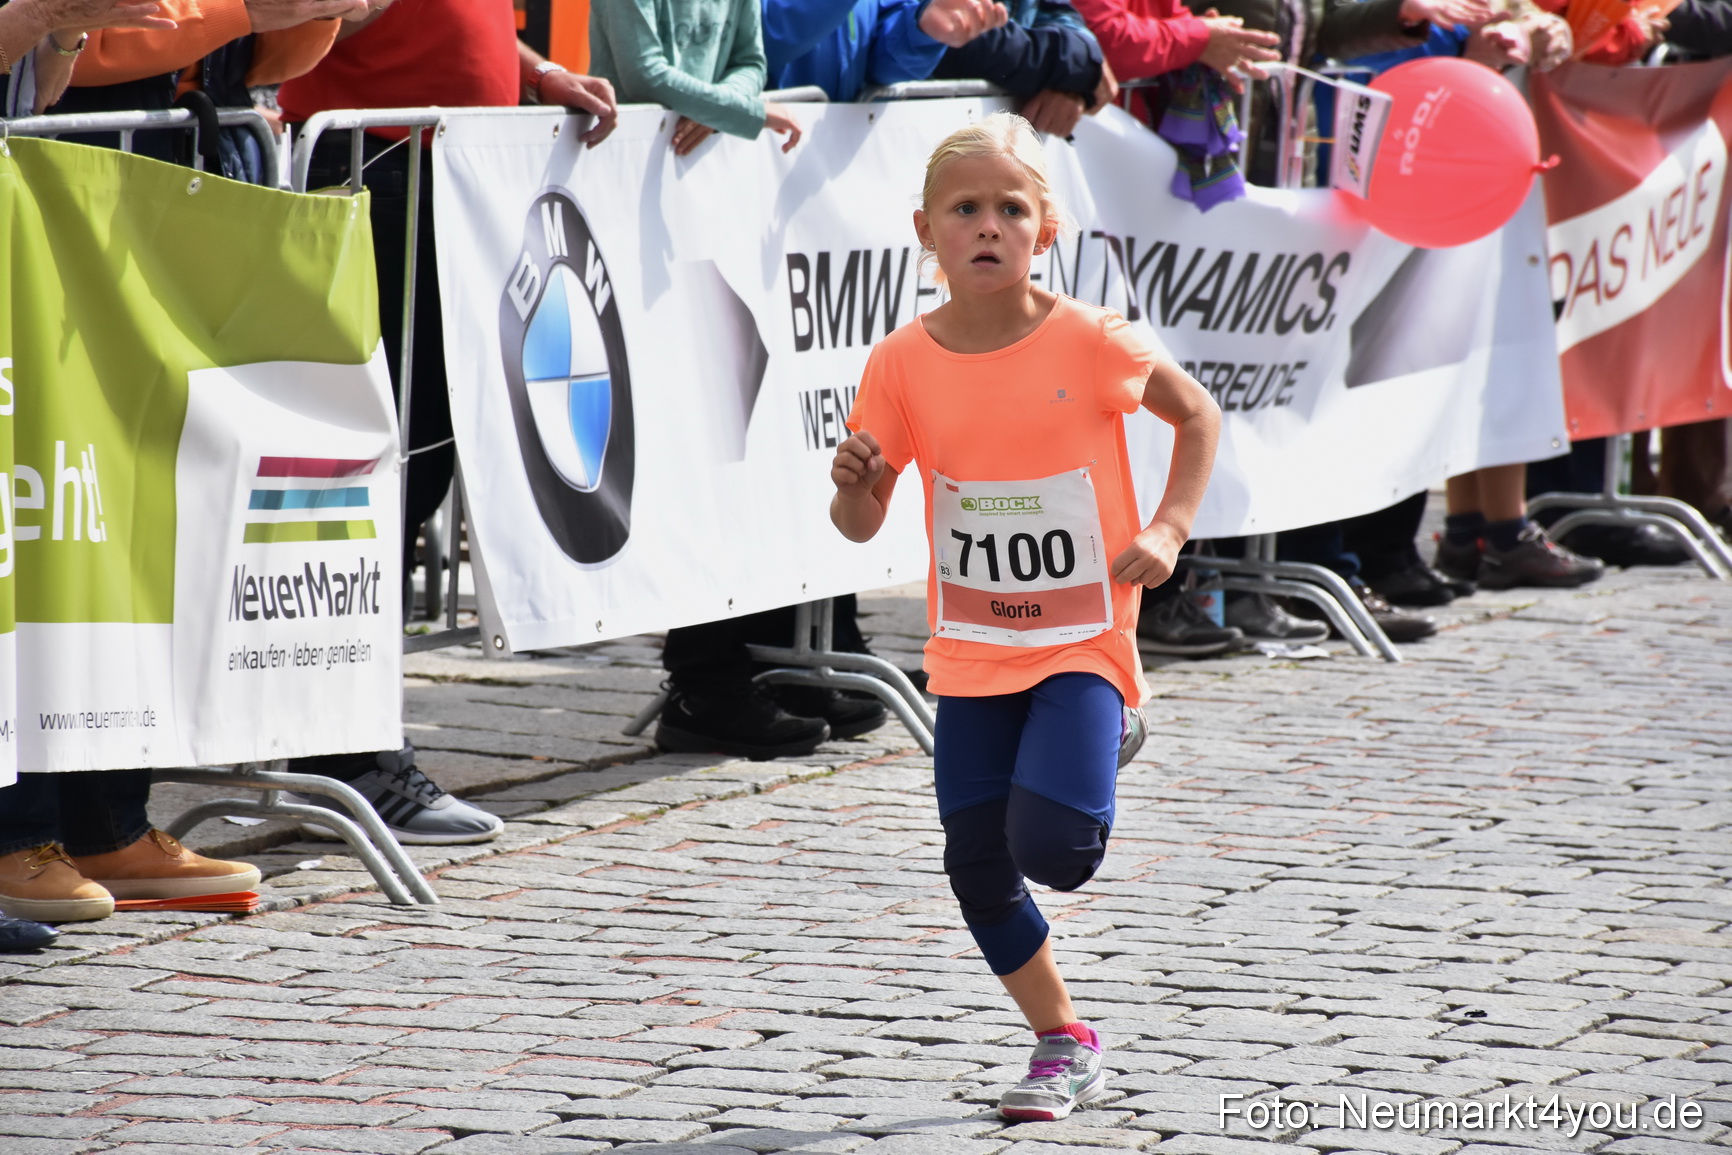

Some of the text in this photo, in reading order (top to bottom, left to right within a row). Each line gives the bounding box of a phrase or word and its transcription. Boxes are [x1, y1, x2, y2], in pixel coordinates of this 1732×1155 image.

[507, 201, 612, 323] BMW
[1550, 160, 1712, 319] DAS NEUE
[786, 247, 909, 352] BMW
[978, 496, 1042, 511] BOCK
[951, 528, 1076, 582] 7100
[228, 557, 381, 622] NeuerMarkt
[990, 600, 1042, 618] Gloria
[229, 643, 286, 671] einkaufen
[292, 642, 324, 667] leben
